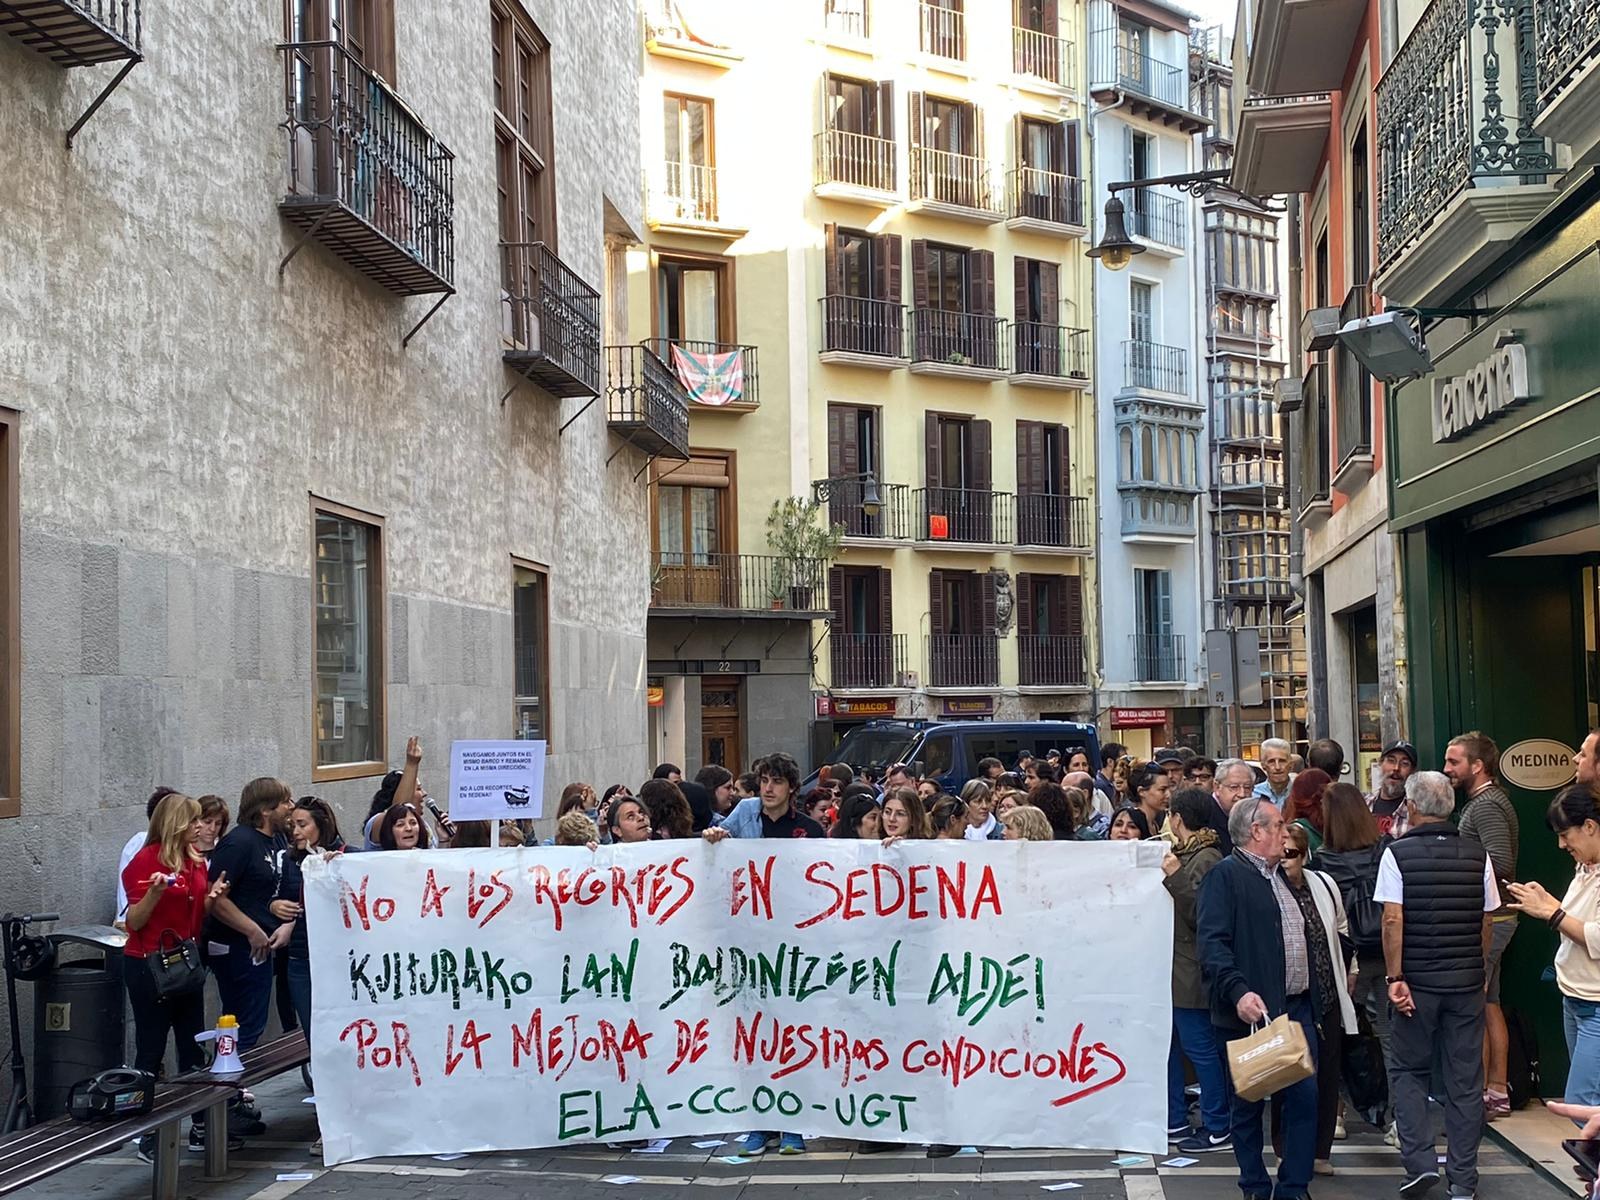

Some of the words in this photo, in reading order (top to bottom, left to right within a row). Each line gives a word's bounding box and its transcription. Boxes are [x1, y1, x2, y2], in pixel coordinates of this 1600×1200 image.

[719, 661, 730, 671] 22
[849, 702, 888, 712] TABACOS
[1511, 753, 1570, 768] MEDINA
[421, 868, 451, 919] A
[730, 854, 777, 920] EN
[794, 860, 1003, 930] SEDENA
[560, 937, 640, 1004] LAN
[444, 1019, 492, 1077] LA
[667, 1018, 711, 1075] DE
